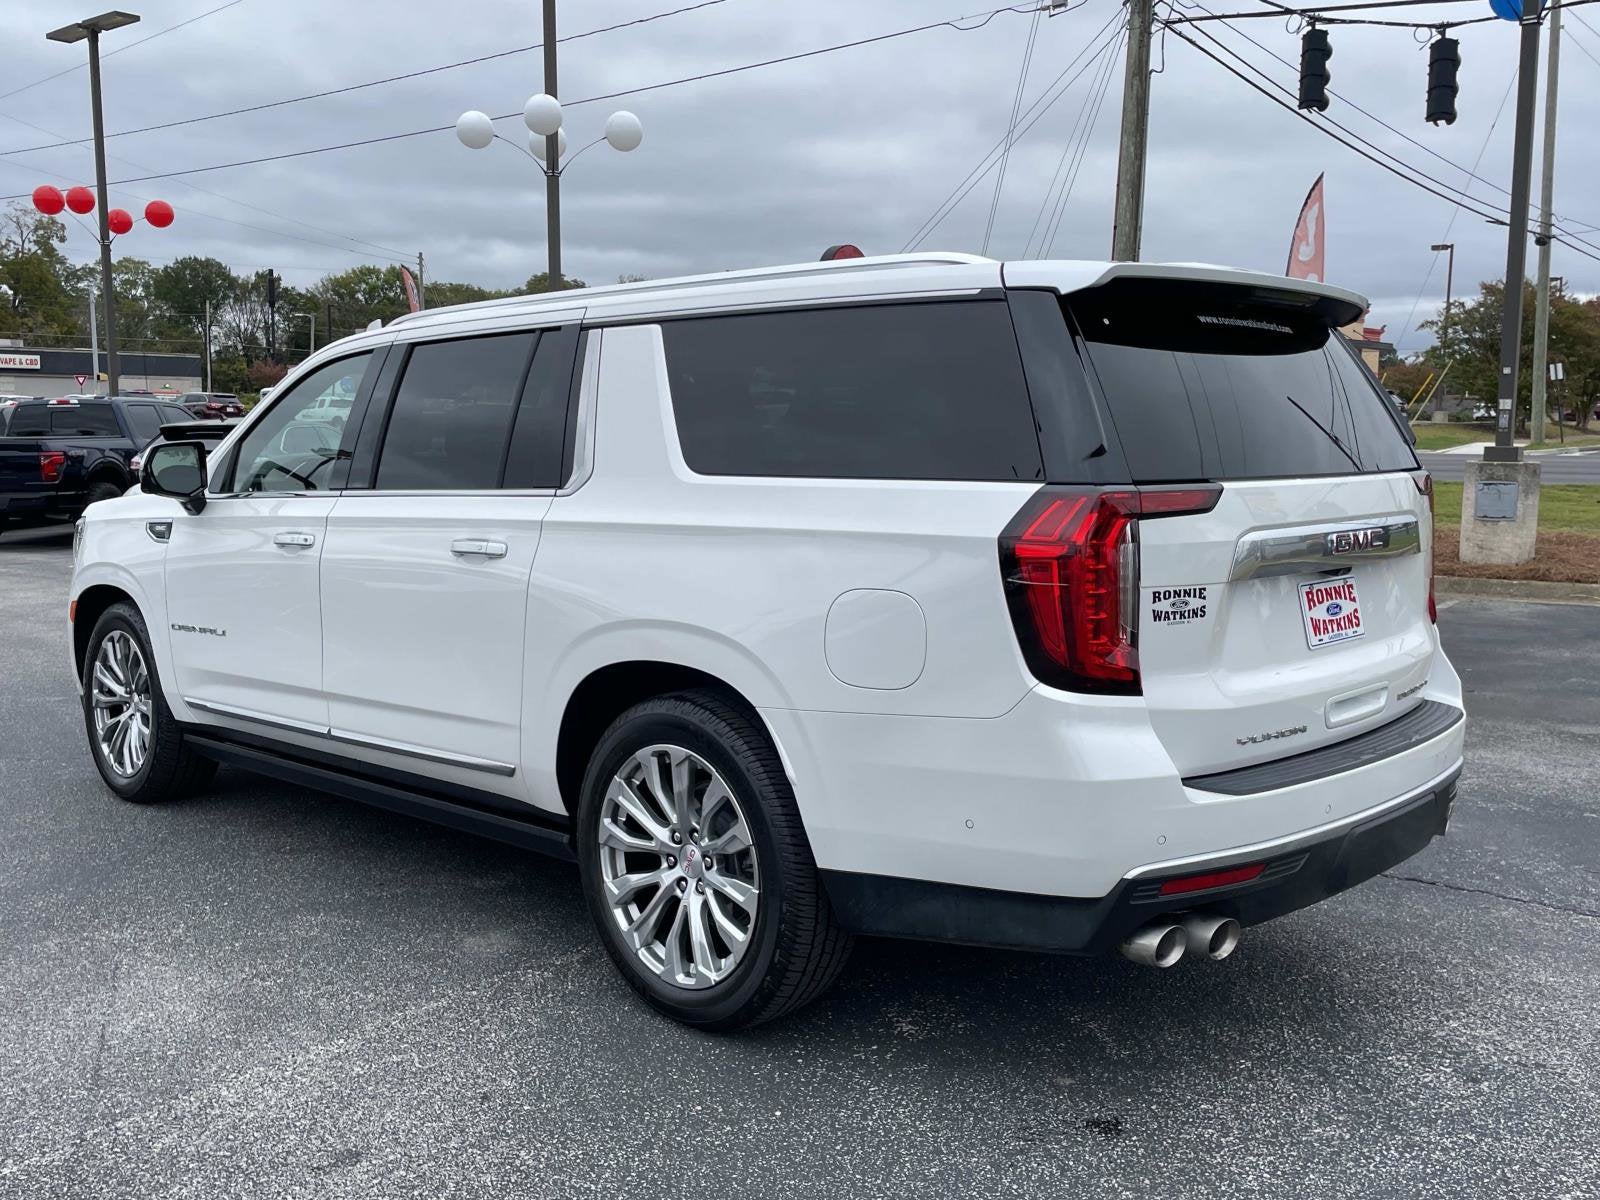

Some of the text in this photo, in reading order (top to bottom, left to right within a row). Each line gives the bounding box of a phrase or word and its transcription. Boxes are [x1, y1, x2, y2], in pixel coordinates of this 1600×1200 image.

[0, 357, 17, 366] VAPE
[25, 358, 39, 367] CBD
[1332, 528, 1384, 555] GMC
[1152, 587, 1207, 605] RONNIE
[1305, 583, 1357, 612] RONNIE
[1152, 605, 1207, 622] WATKINS
[1328, 603, 1342, 615] Ford
[171, 624, 227, 637] DENALI
[1310, 607, 1361, 637] WATKINS
[1236, 725, 1308, 746] YUKON
[684, 849, 696, 874] GMC
